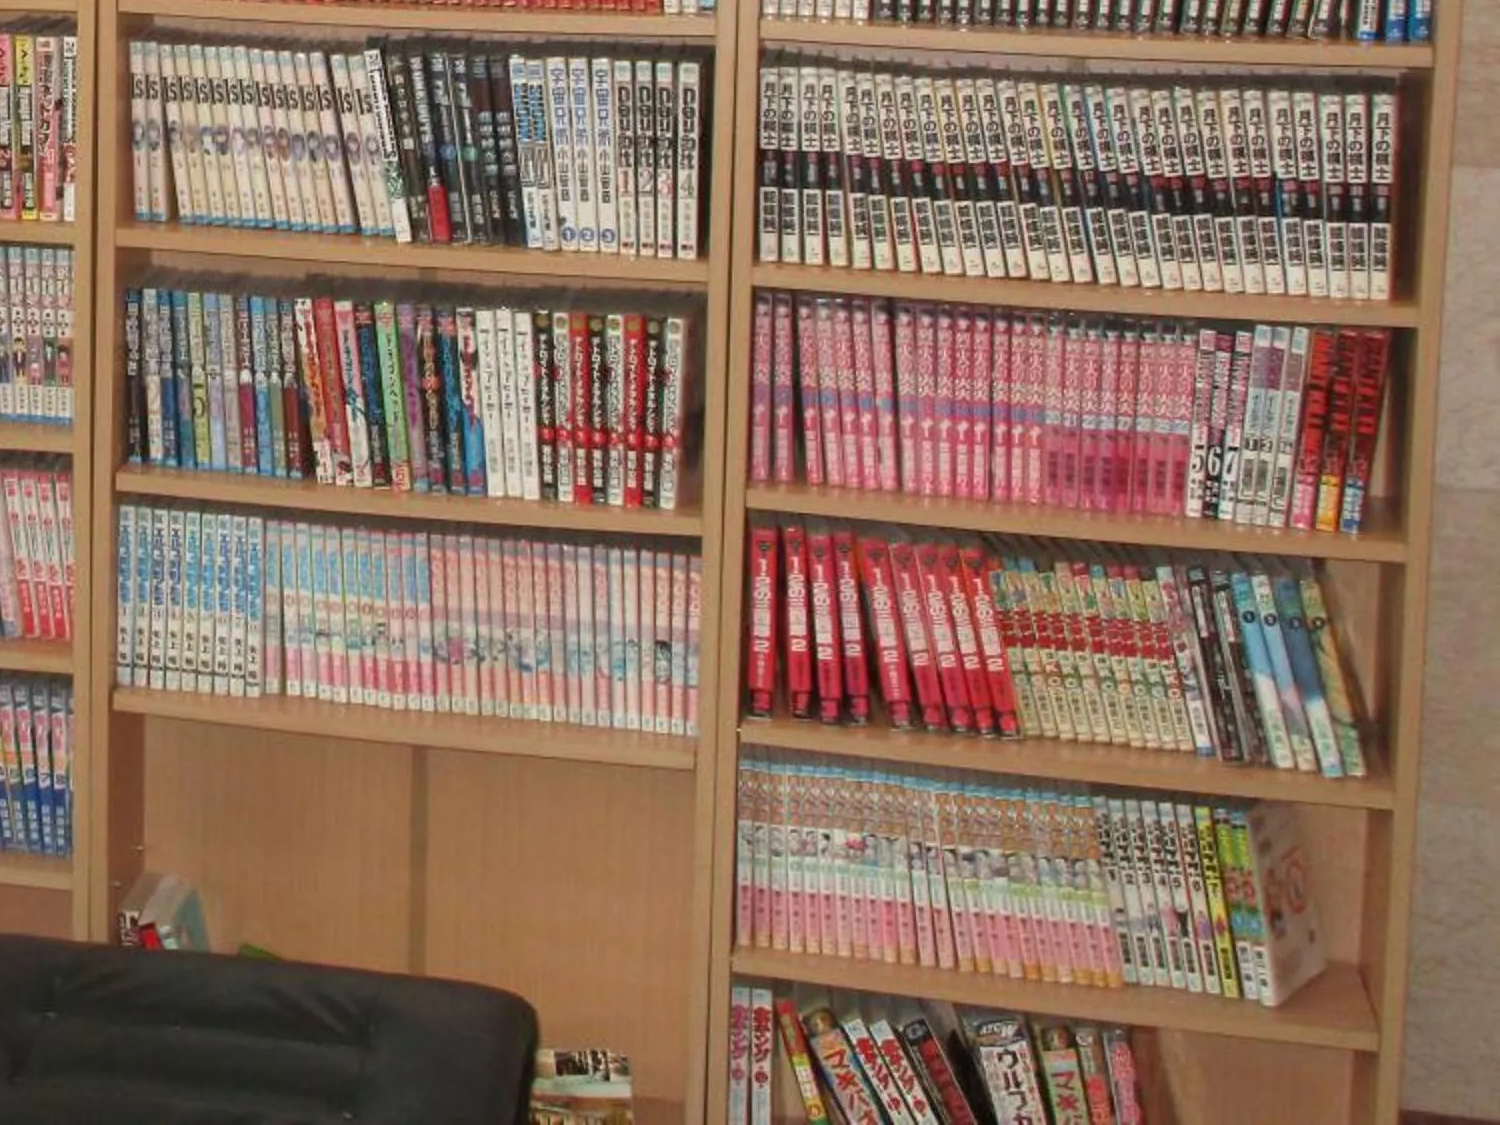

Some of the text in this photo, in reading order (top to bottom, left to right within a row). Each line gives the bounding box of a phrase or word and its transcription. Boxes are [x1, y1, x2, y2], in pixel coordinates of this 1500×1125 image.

[1192, 445, 1204, 472] 5
[1208, 446, 1221, 475] 6
[1225, 446, 1239, 475] 7
